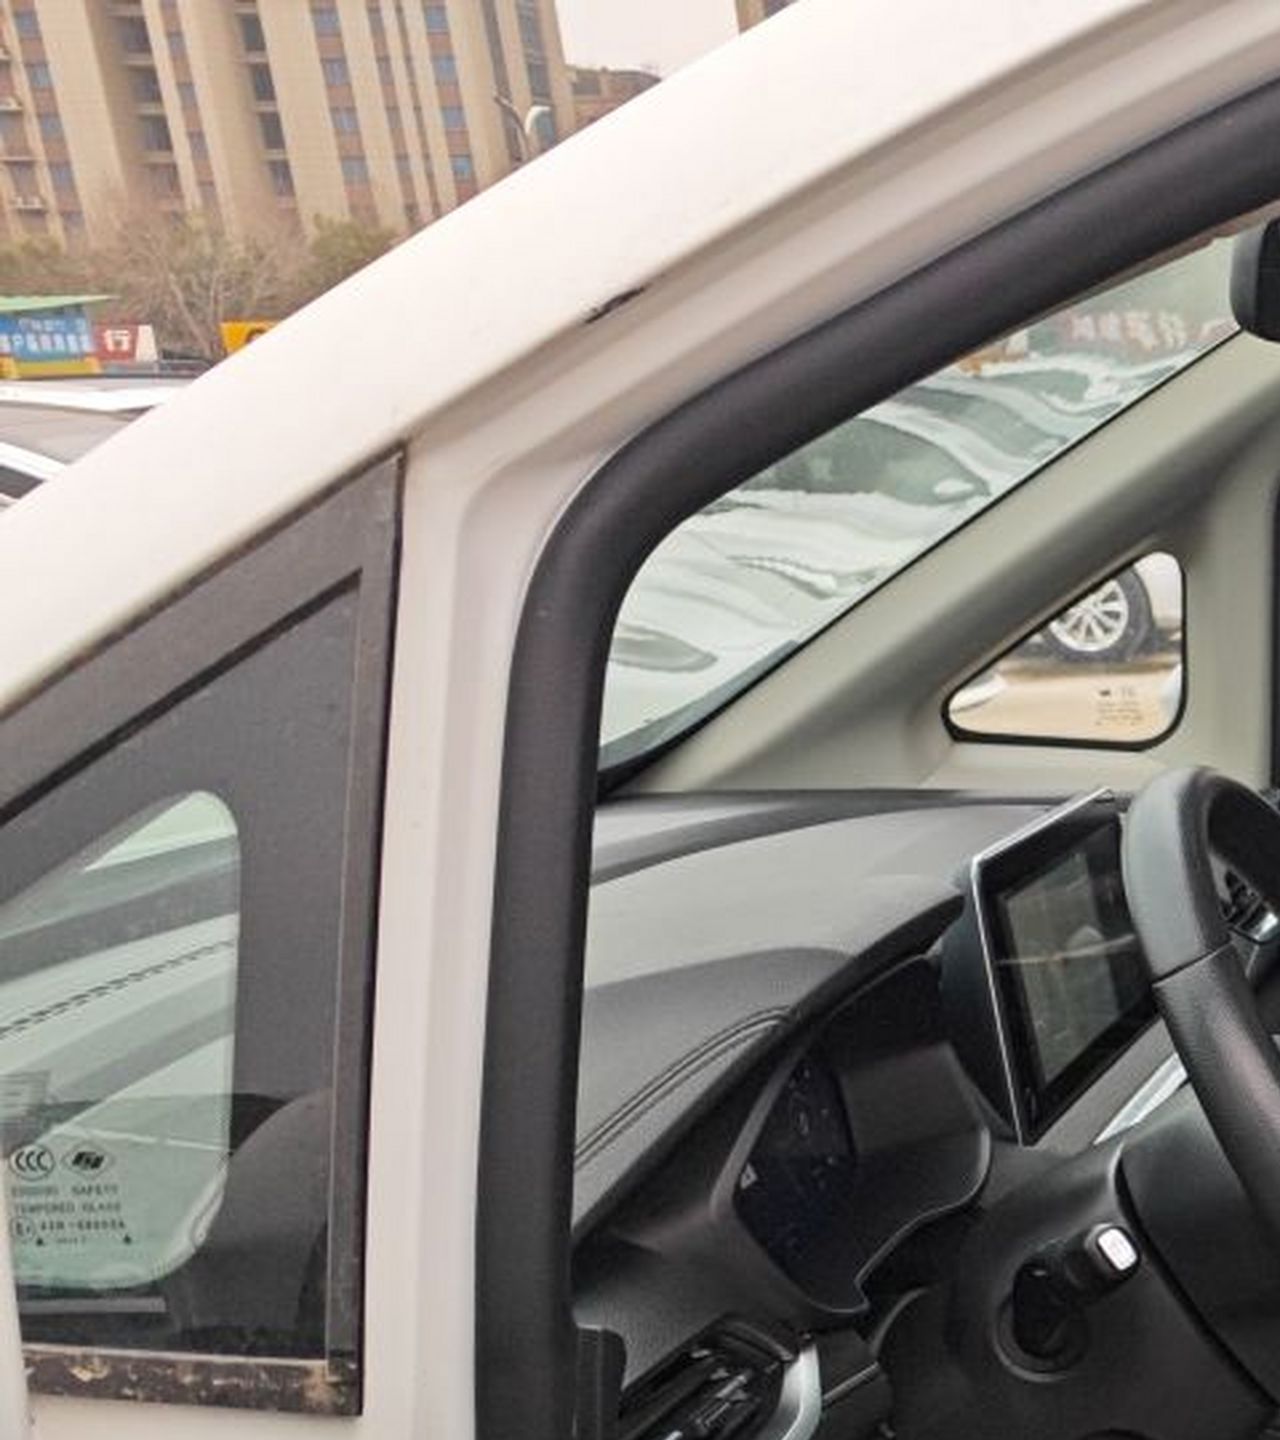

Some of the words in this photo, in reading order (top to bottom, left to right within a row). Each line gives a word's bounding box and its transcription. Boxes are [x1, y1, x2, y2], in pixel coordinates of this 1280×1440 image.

[15, 1150, 48, 1172] CCC
[71, 1184, 119, 1196] SAFETY
[14, 1202, 76, 1214] TEMPERED
